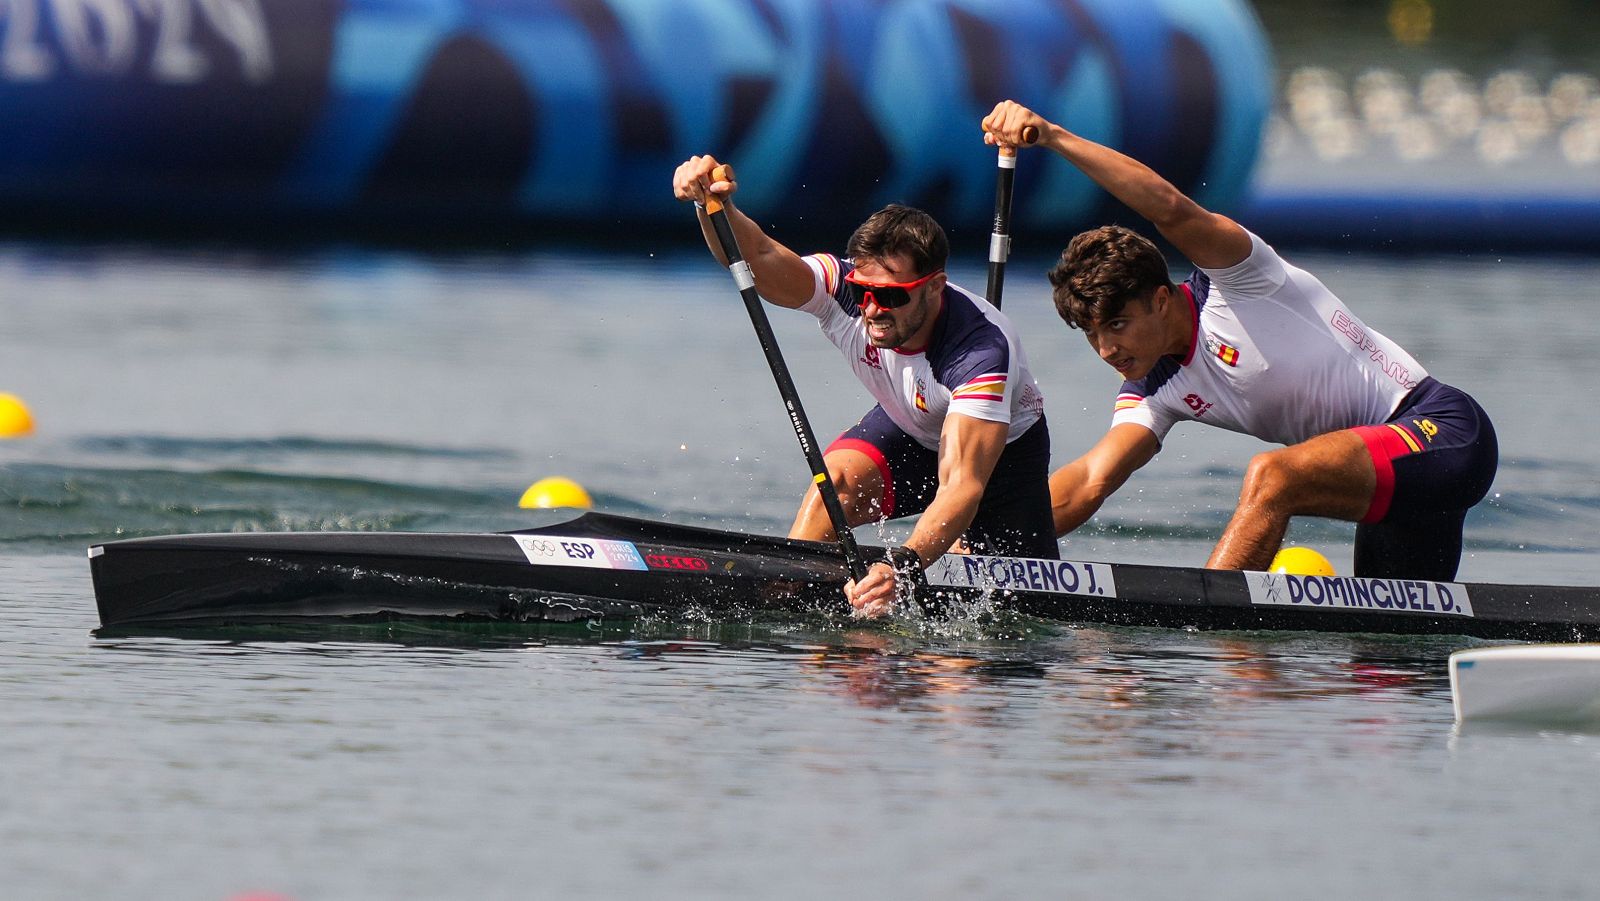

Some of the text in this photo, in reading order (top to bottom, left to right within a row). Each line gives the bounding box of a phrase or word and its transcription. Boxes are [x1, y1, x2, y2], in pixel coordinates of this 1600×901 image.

[790, 411, 810, 453] PARIS 2024
[560, 541, 595, 560] ESP
[604, 543, 633, 553] PARIS
[610, 552, 639, 563] 2024
[962, 555, 1104, 595] MORENO J.
[1285, 573, 1462, 613] DOMINGUEZ D.
